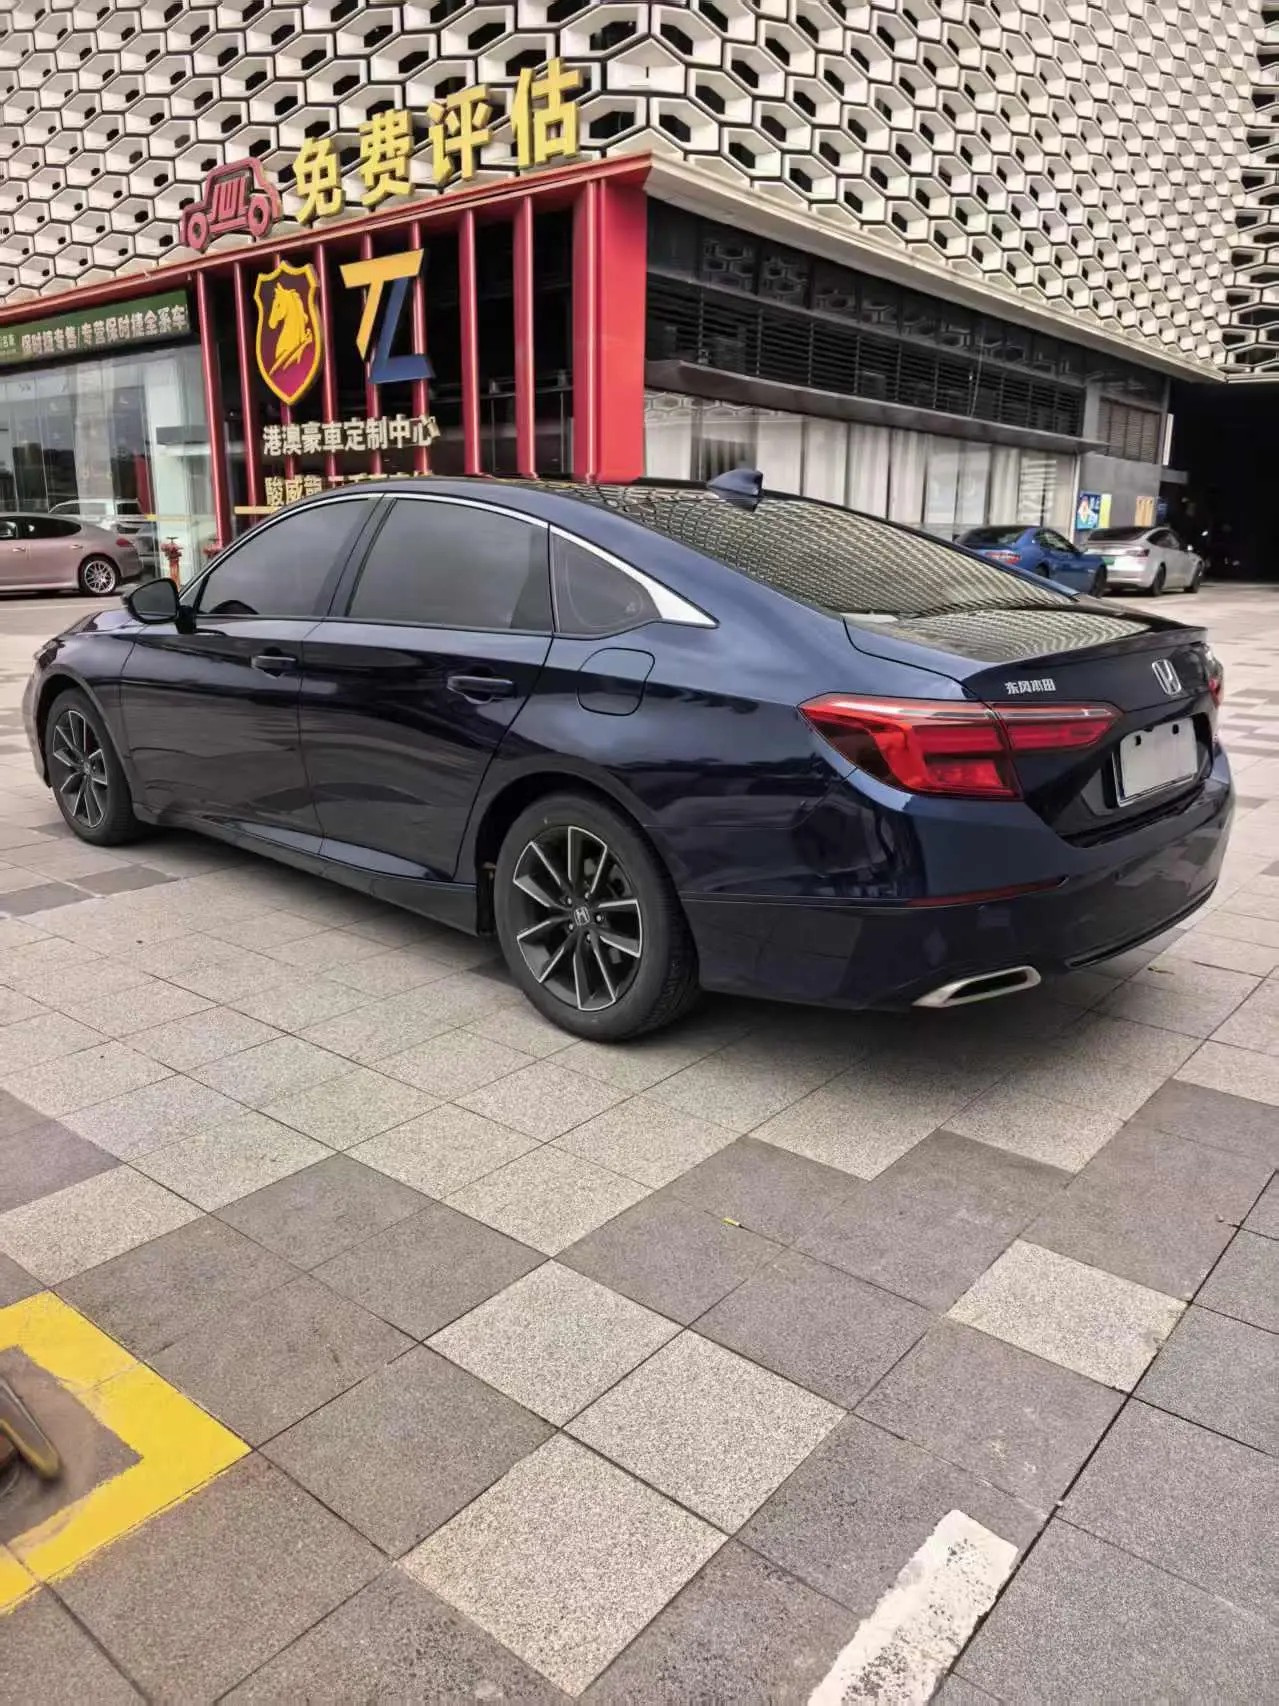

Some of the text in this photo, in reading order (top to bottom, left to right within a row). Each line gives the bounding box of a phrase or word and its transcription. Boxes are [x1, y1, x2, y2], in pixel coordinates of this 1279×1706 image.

[292, 57, 584, 225] 免费评估
[263, 413, 434, 457] 港澳豪車定制中心
[1004, 678, 1056, 695] 东风本田
